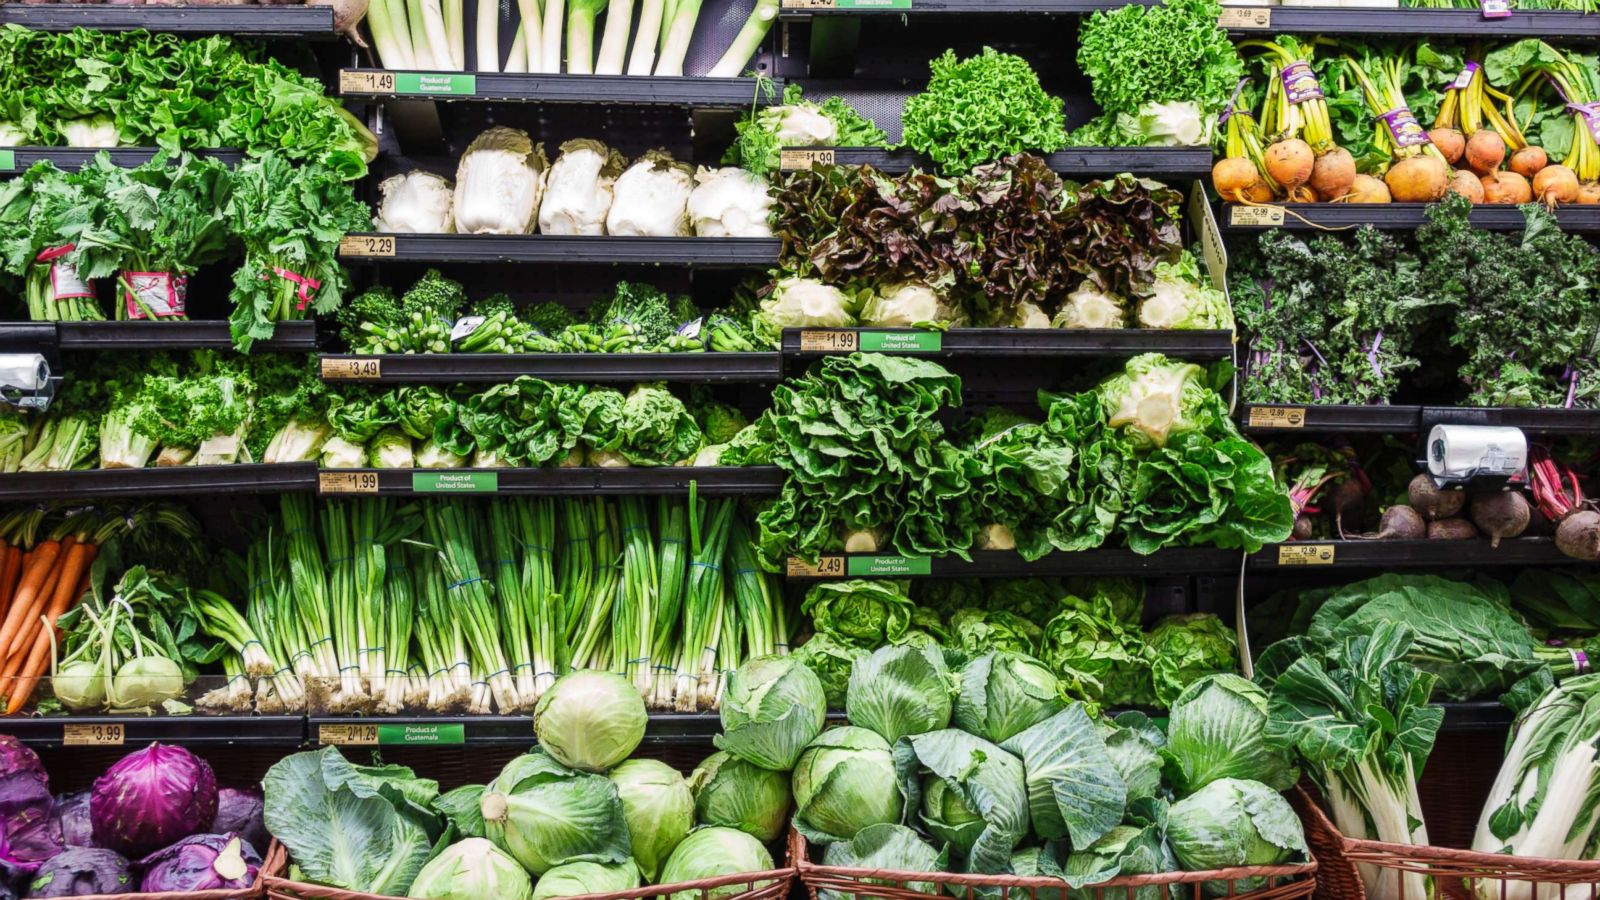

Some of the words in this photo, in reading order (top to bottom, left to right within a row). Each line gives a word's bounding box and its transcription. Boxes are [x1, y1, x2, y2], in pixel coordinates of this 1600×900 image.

[366, 74, 392, 89] $1.49
[420, 84, 452, 92] Guatemala
[806, 151, 832, 165] $199
[365, 238, 392, 253] $2.29
[827, 333, 854, 347] $1.99
[349, 361, 377, 376] $3.49
[348, 474, 376, 488] $1.99
[92, 726, 120, 740] $3.99
